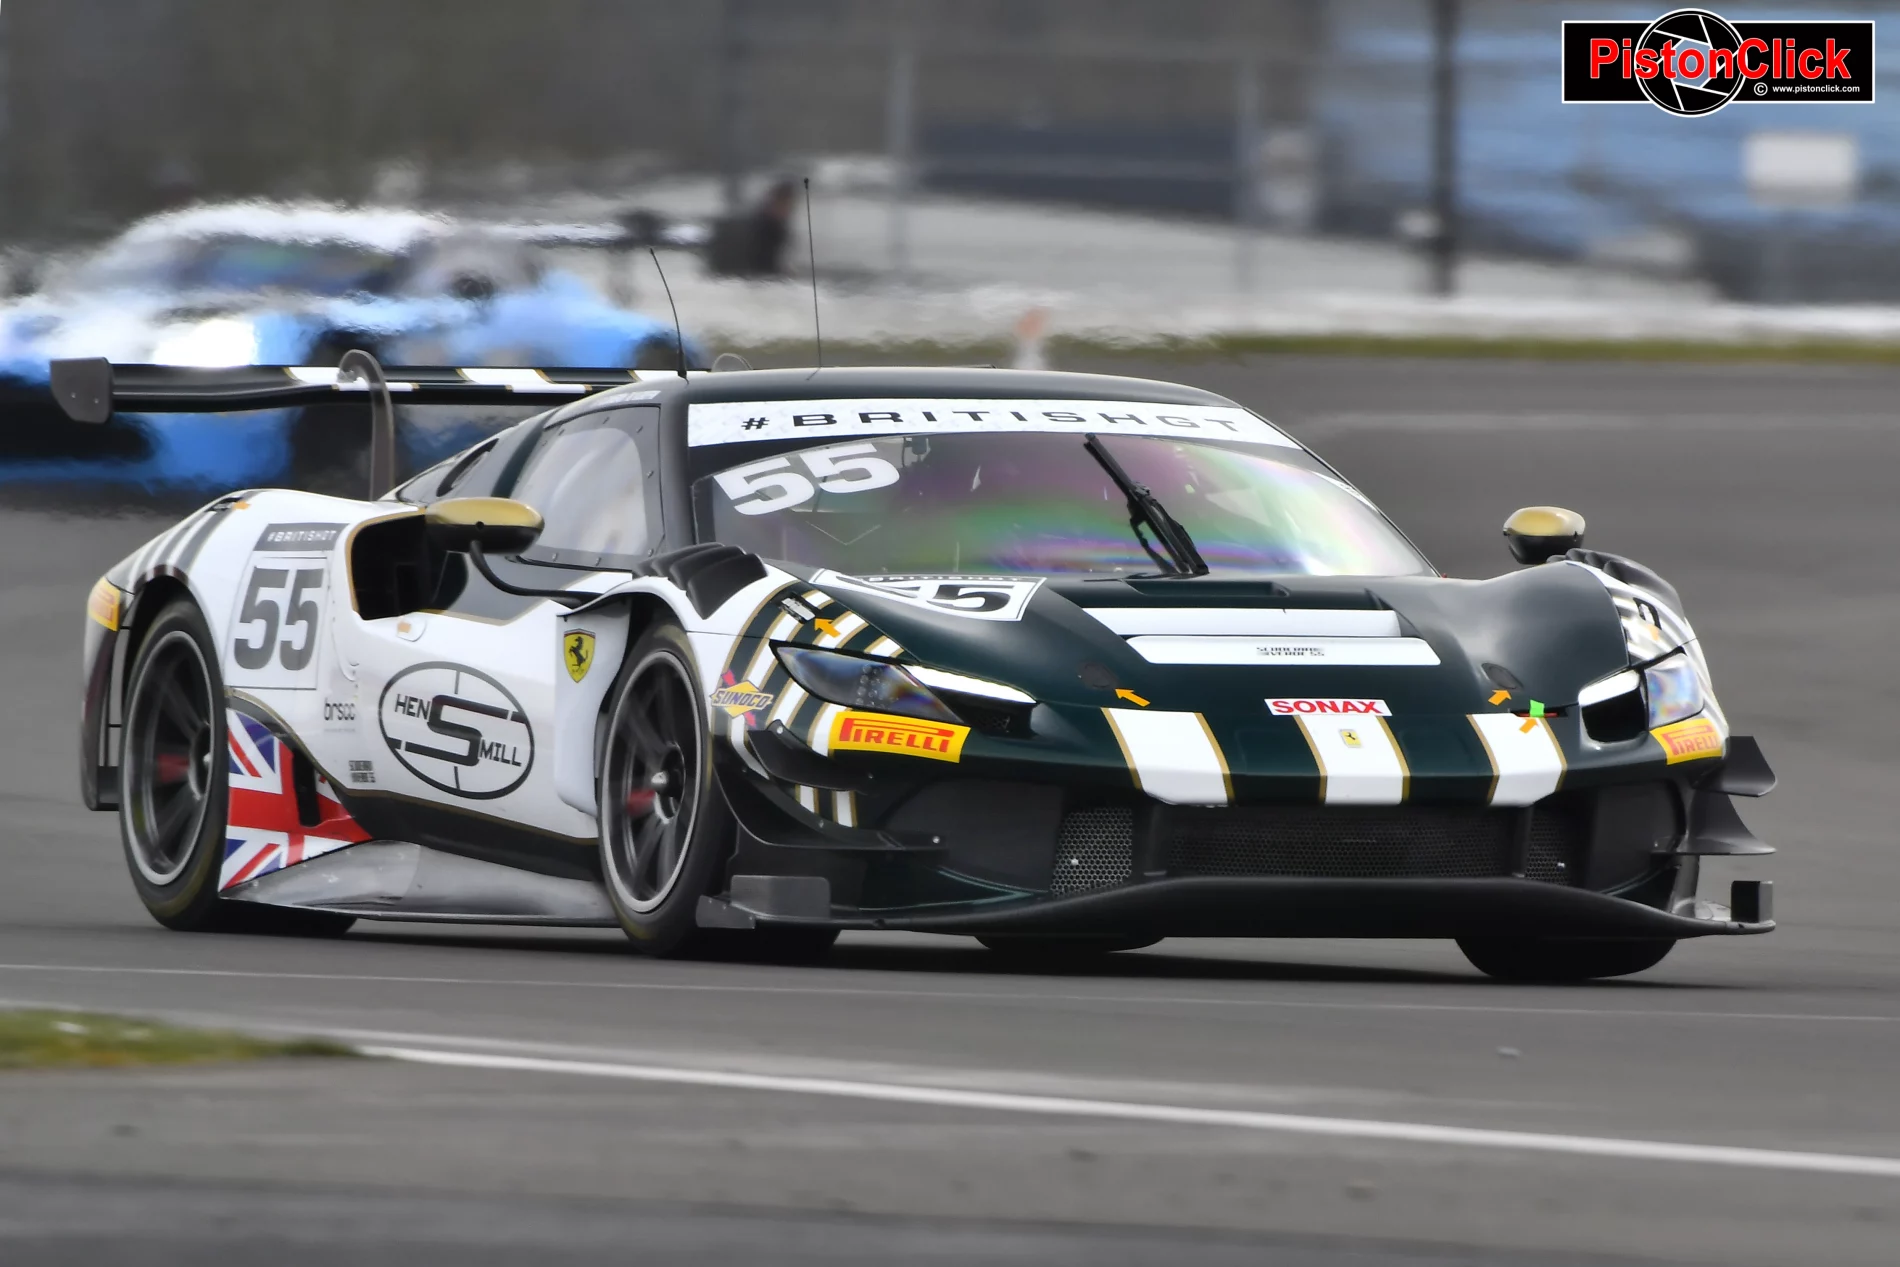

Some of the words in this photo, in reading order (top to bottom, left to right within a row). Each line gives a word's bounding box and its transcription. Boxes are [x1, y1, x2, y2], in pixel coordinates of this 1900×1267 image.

[712, 442, 901, 516] 55
[233, 566, 325, 671] 55
[713, 690, 771, 708] SUNOCO
[1272, 700, 1384, 715] SONAX
[839, 717, 955, 753] PIRELLI
